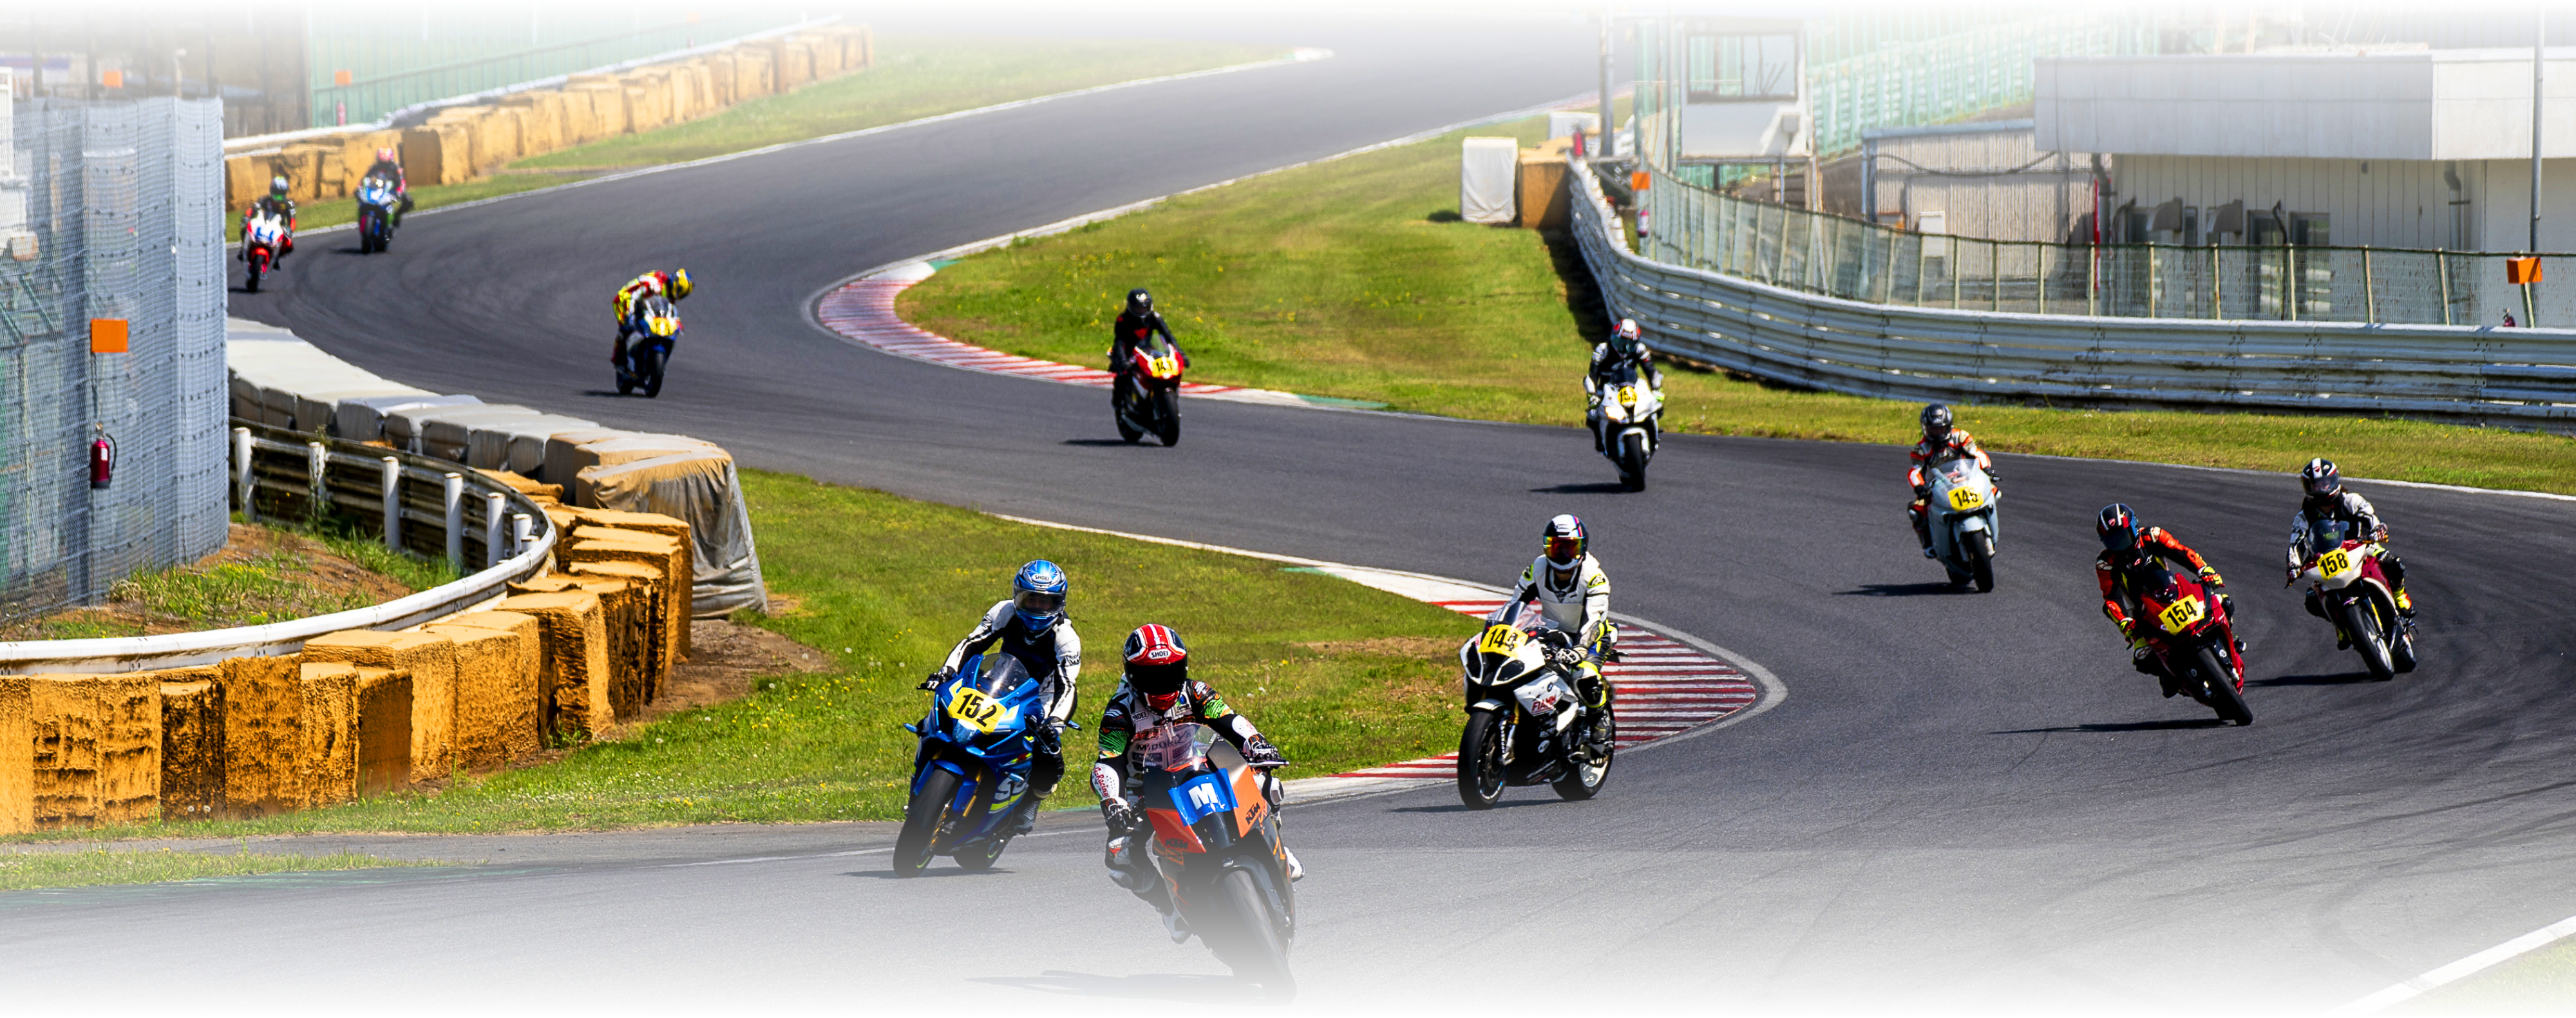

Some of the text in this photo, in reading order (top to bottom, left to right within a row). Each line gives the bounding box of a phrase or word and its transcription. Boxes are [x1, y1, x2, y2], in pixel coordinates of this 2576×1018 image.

[2320, 552, 2348, 577] 158
[2166, 600, 2198, 628] 154
[1488, 628, 1519, 652] 144
[956, 693, 998, 728] 152
[1093, 767, 1109, 798] G-Racing
[1188, 782, 1219, 810] M
[1245, 802, 1261, 825] KTM
[1165, 838, 1189, 850] KTM
